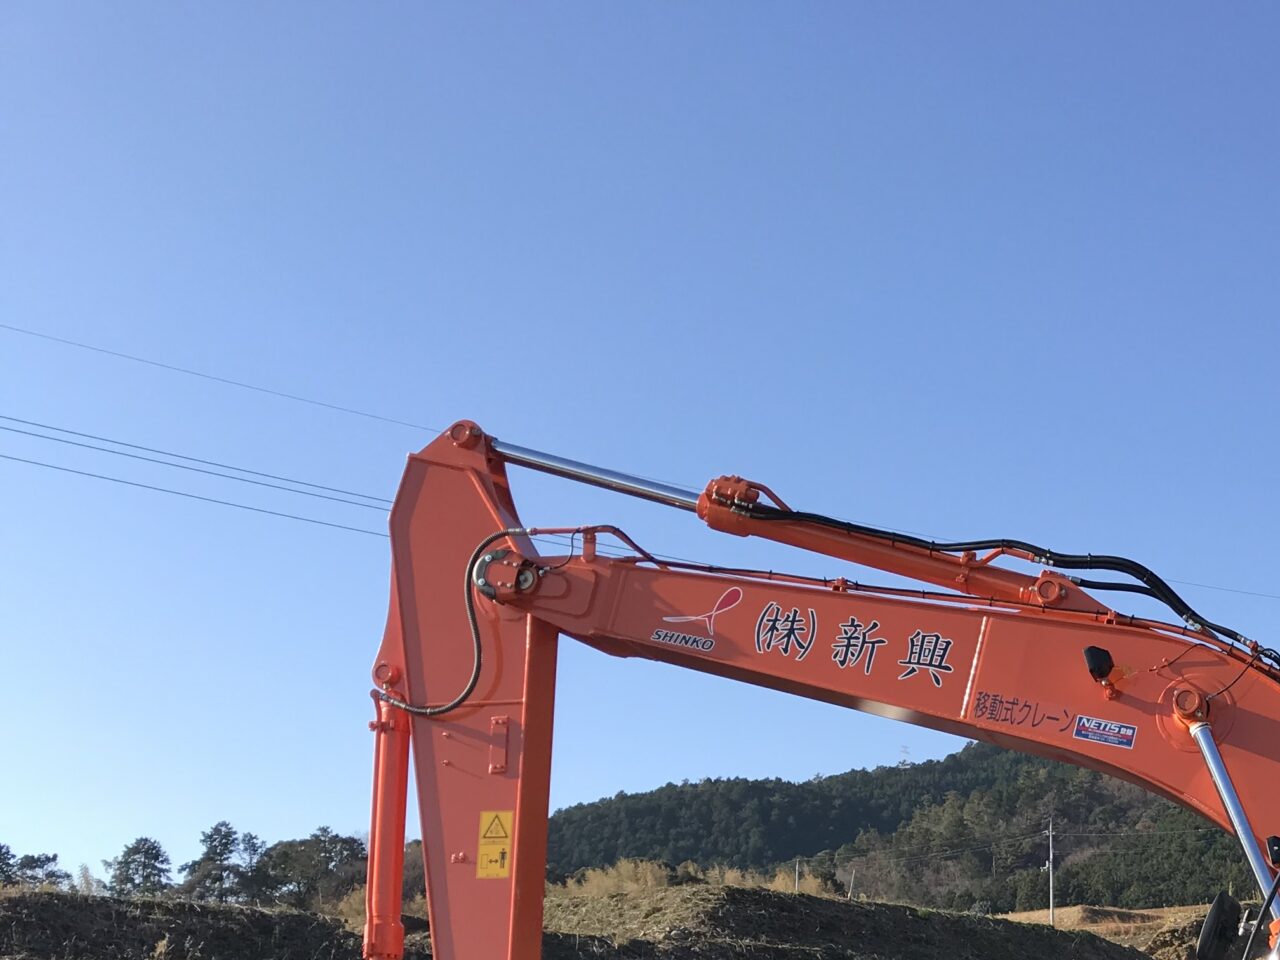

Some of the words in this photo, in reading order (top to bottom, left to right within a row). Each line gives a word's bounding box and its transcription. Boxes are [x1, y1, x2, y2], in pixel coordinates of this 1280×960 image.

[651, 629, 715, 651] SHINKO
[974, 691, 1076, 732] 移動式クレーン
[1080, 717, 1121, 734] NETIS
